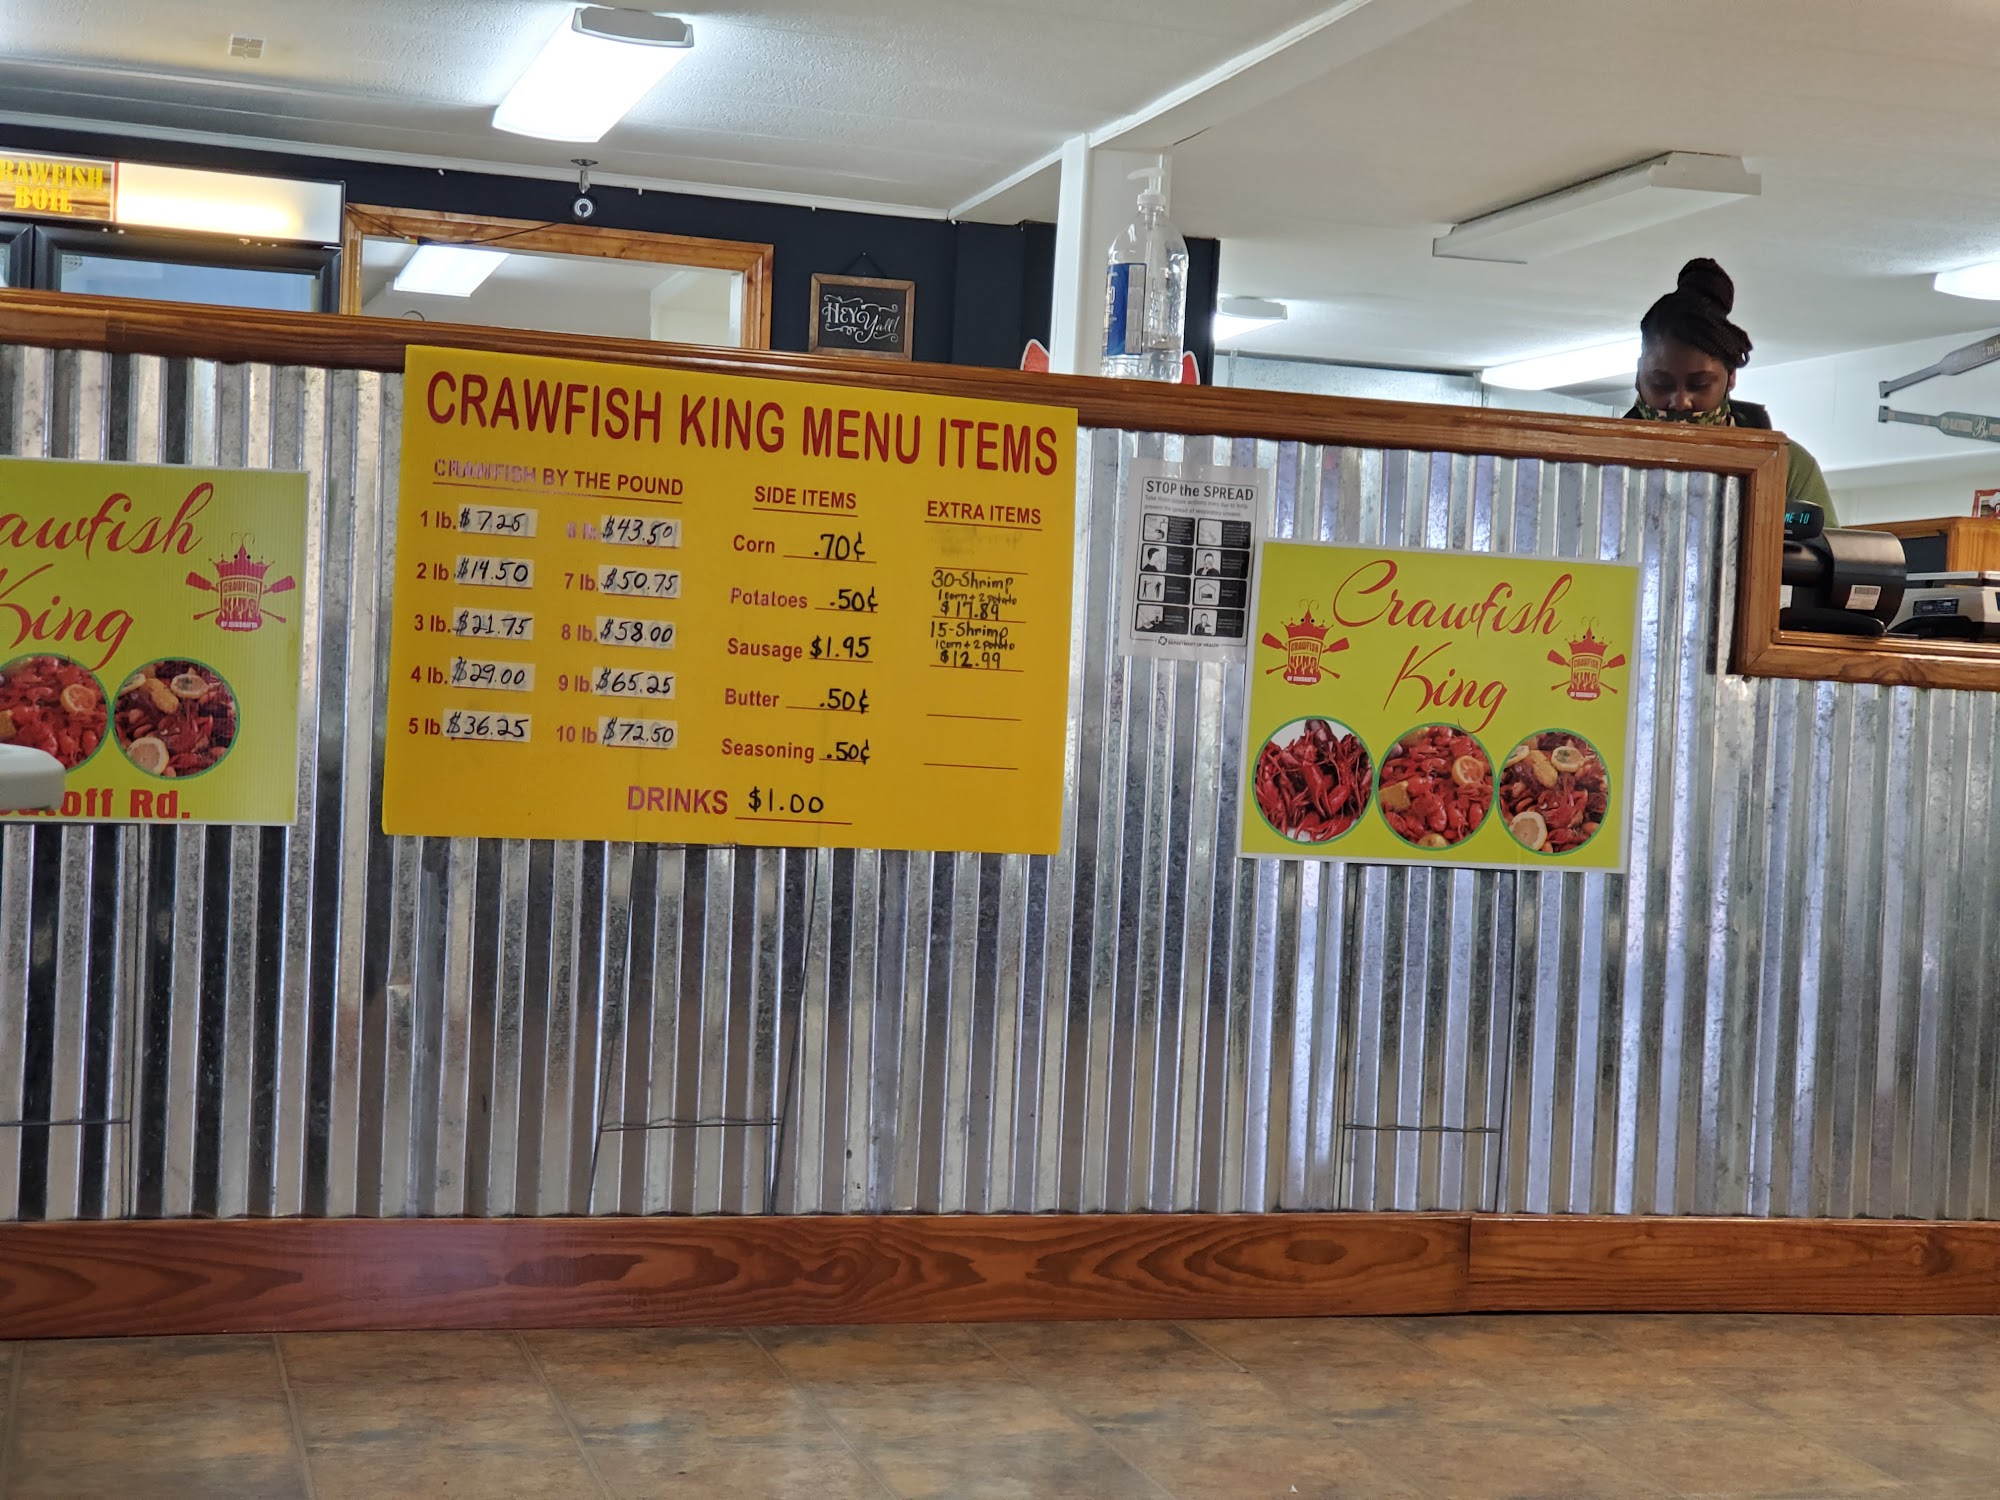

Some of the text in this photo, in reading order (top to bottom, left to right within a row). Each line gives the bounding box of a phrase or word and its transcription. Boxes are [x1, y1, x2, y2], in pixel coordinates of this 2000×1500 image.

[14, 185, 73, 213] BOIL
[428, 371, 1058, 476] CRAWFISH KING MENU ITEMS
[433, 458, 684, 495] CRAWFISH BY THE POUND
[754, 485, 857, 510] SIDE ITEMS
[1146, 480, 1254, 501] STOP the SPREAD
[421, 507, 526, 532] 1 lb. $7.25
[927, 500, 1041, 524] EXTRA ITEMS
[603, 515, 673, 545] $43.50
[733, 534, 776, 554] Corn
[416, 562, 426, 579] 2
[457, 557, 528, 582] $14.50
[564, 573, 574, 590] 7
[601, 567, 678, 593] $50.75
[730, 587, 808, 609] Potatoes
[941, 600, 999, 621] $17.89
[1333, 559, 1573, 639] Crawfish
[414, 610, 533, 636] 3 lb. $21.75
[562, 623, 571, 640] 8
[600, 619, 673, 643] $58.00
[727, 635, 871, 662] Sausage $1.95
[941, 649, 1000, 670] $12.99
[411, 656, 525, 685] 4 lb. $29.00
[559, 674, 568, 691] 9
[596, 667, 674, 693] $65.25
[724, 688, 780, 707] Butter
[1383, 641, 1509, 733] King
[409, 717, 419, 735] 5
[446, 711, 529, 737] $36.25
[557, 725, 576, 743] 10
[602, 717, 674, 744] $72.50
[721, 737, 815, 764] Seasoning
[130, 789, 191, 819] Rd.
[628, 785, 824, 815] DRINKS $1.00
